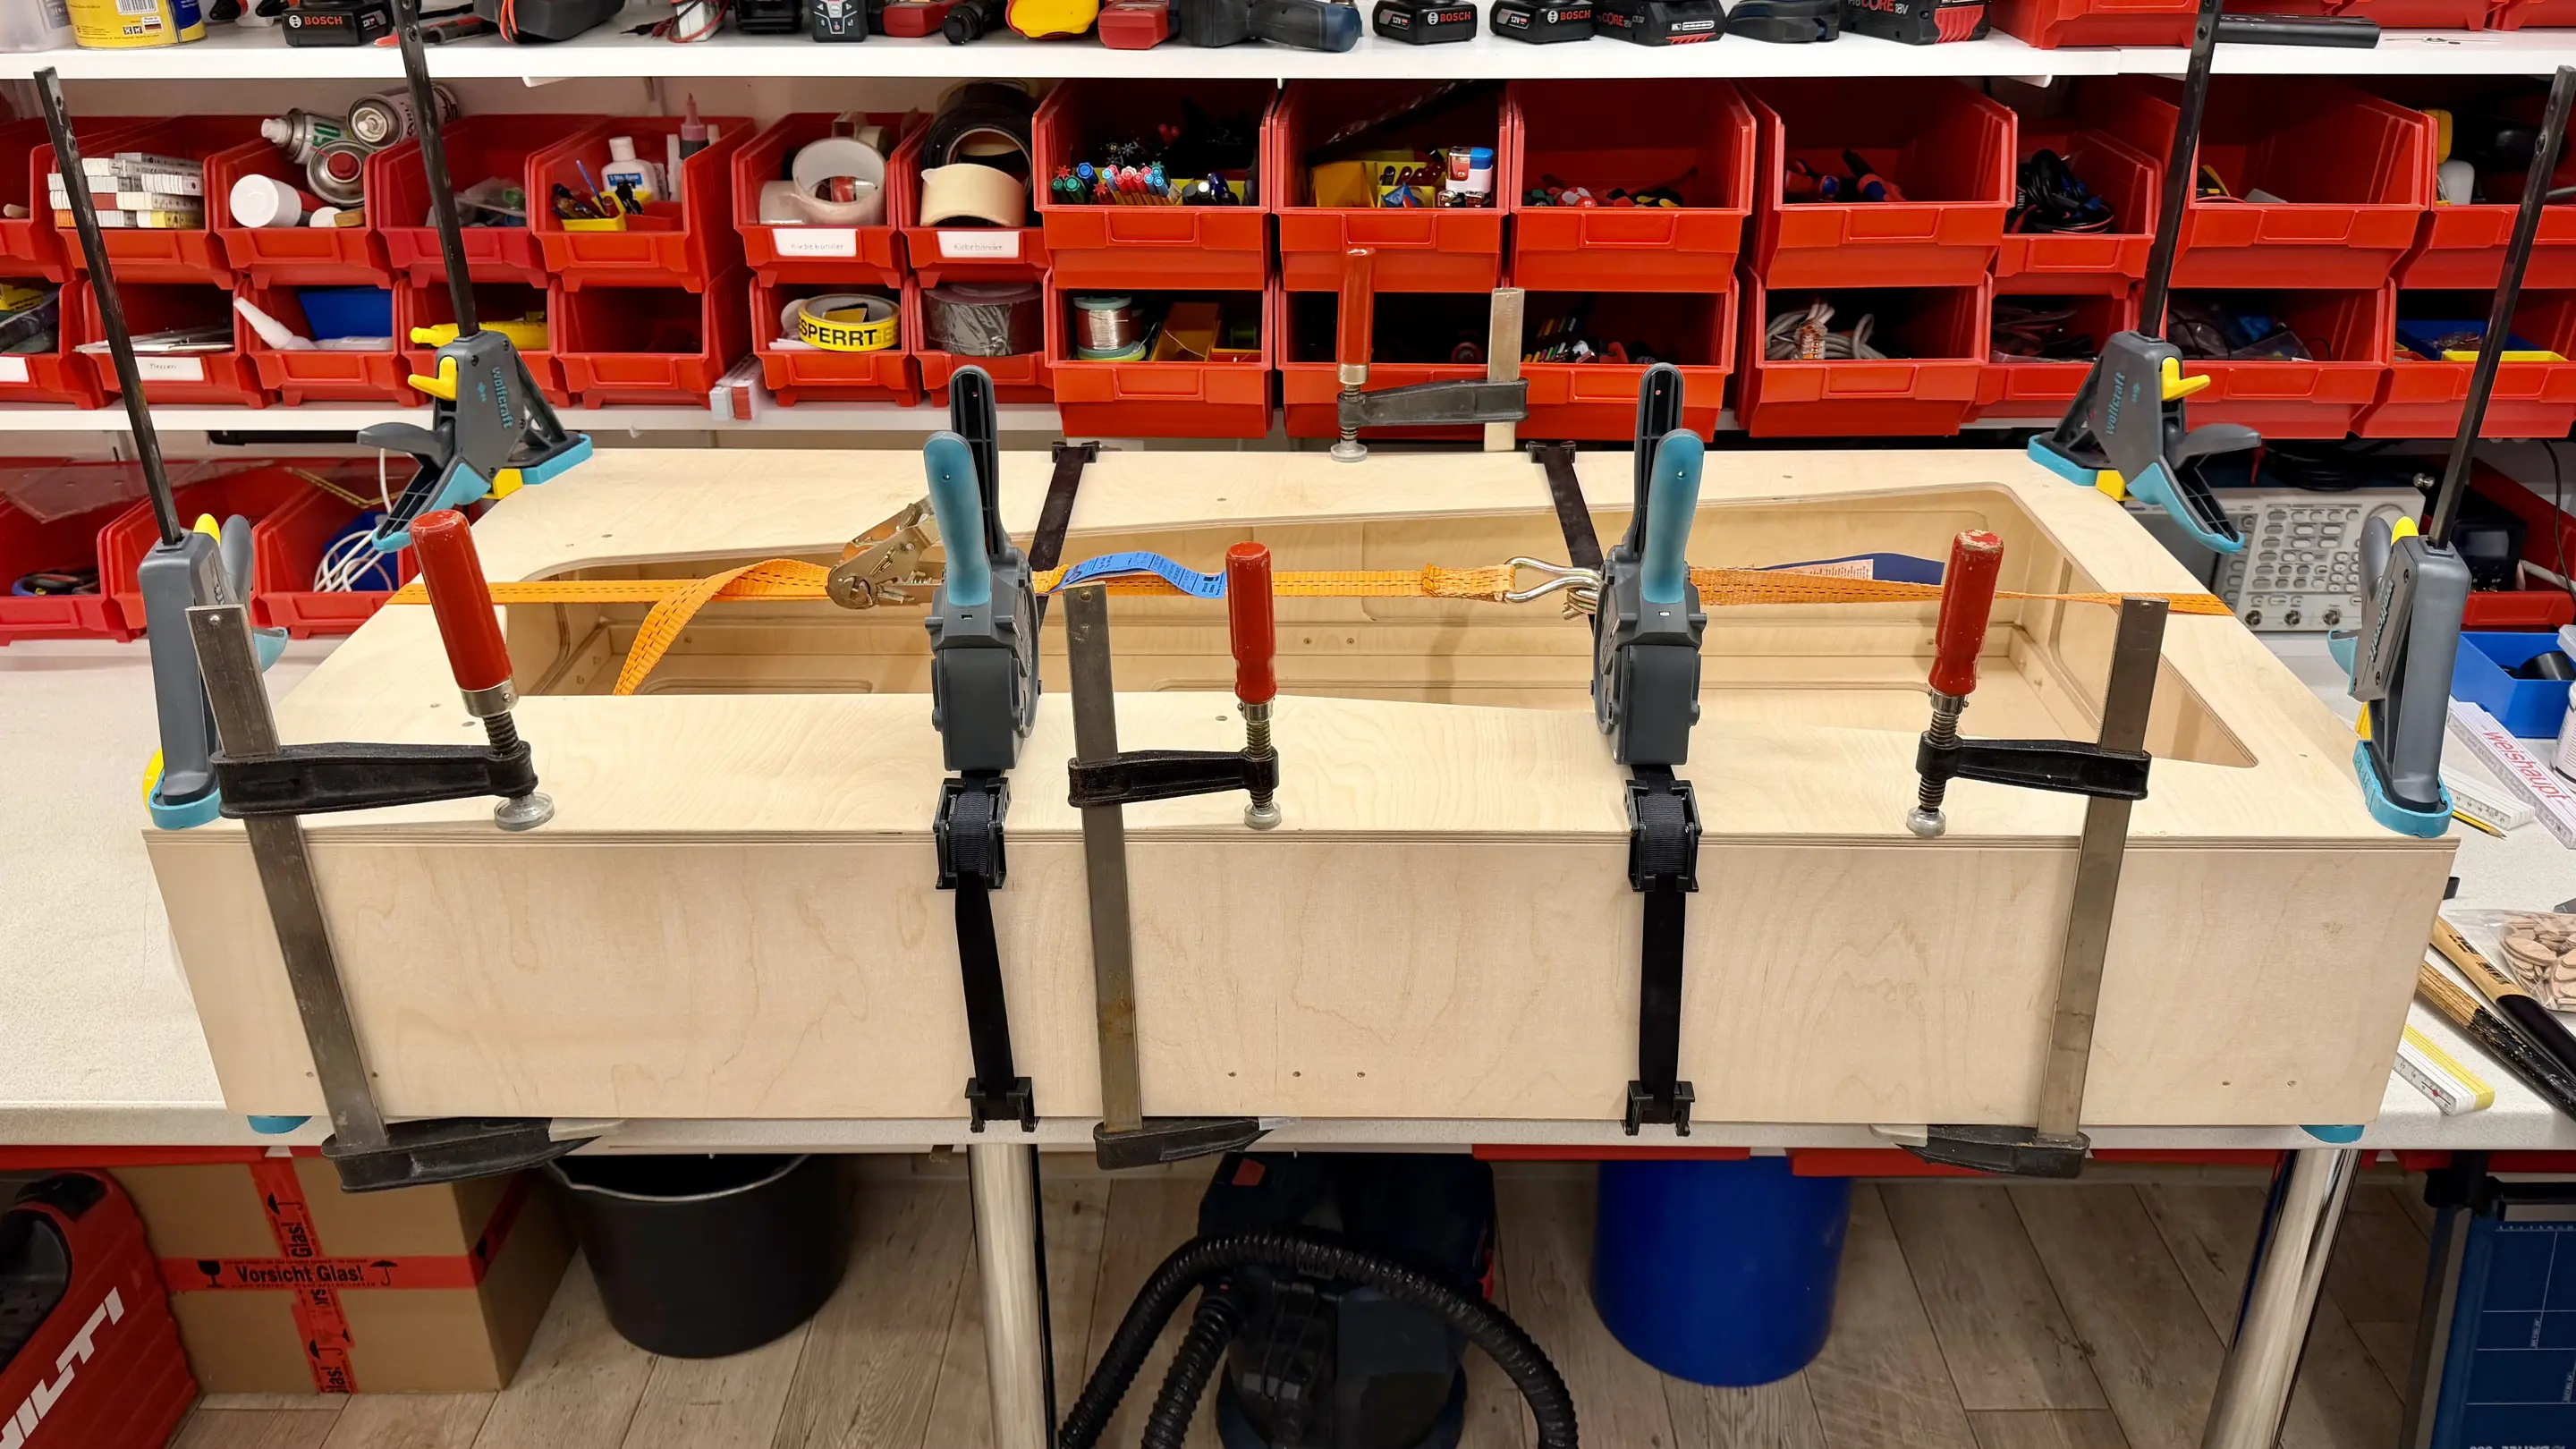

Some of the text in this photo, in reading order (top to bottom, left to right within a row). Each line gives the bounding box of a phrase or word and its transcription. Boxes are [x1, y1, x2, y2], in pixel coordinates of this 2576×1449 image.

[304, 15, 343, 25] BOSCH
[1440, 12, 1471, 22] BOSCH
[1560, 10, 1591, 21] BOSCH
[799, 317, 877, 347] SPERRT
[492, 366, 515, 429] wolfcraft
[2106, 371, 2126, 436] wolfcraft
[2483, 732, 2572, 801] weishaupt
[235, 1265, 365, 1283] Vorsicht Glas!
